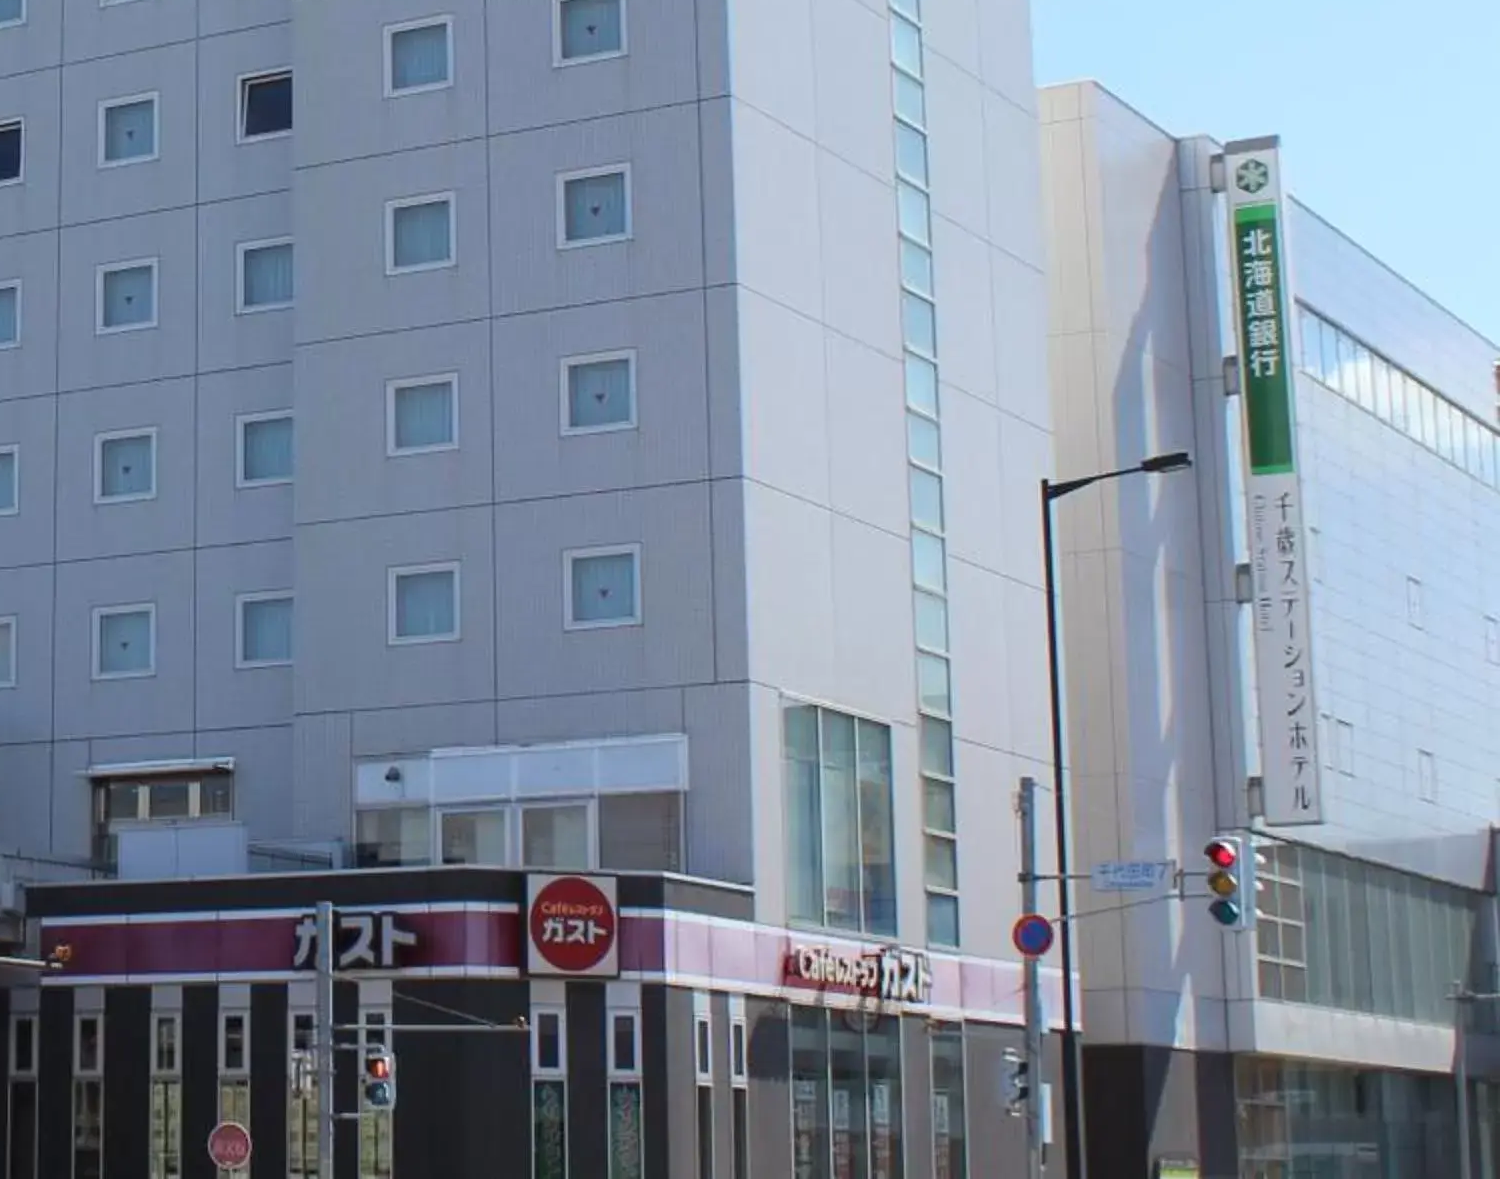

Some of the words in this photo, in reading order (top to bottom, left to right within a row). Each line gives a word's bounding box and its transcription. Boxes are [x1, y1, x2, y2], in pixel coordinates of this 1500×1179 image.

[1243, 228, 1278, 377] 北海道銀行
[1274, 491, 1310, 811] 千歳ステーションホテル
[542, 917, 608, 945] ガスト
[881, 947, 933, 1004] ガスト
